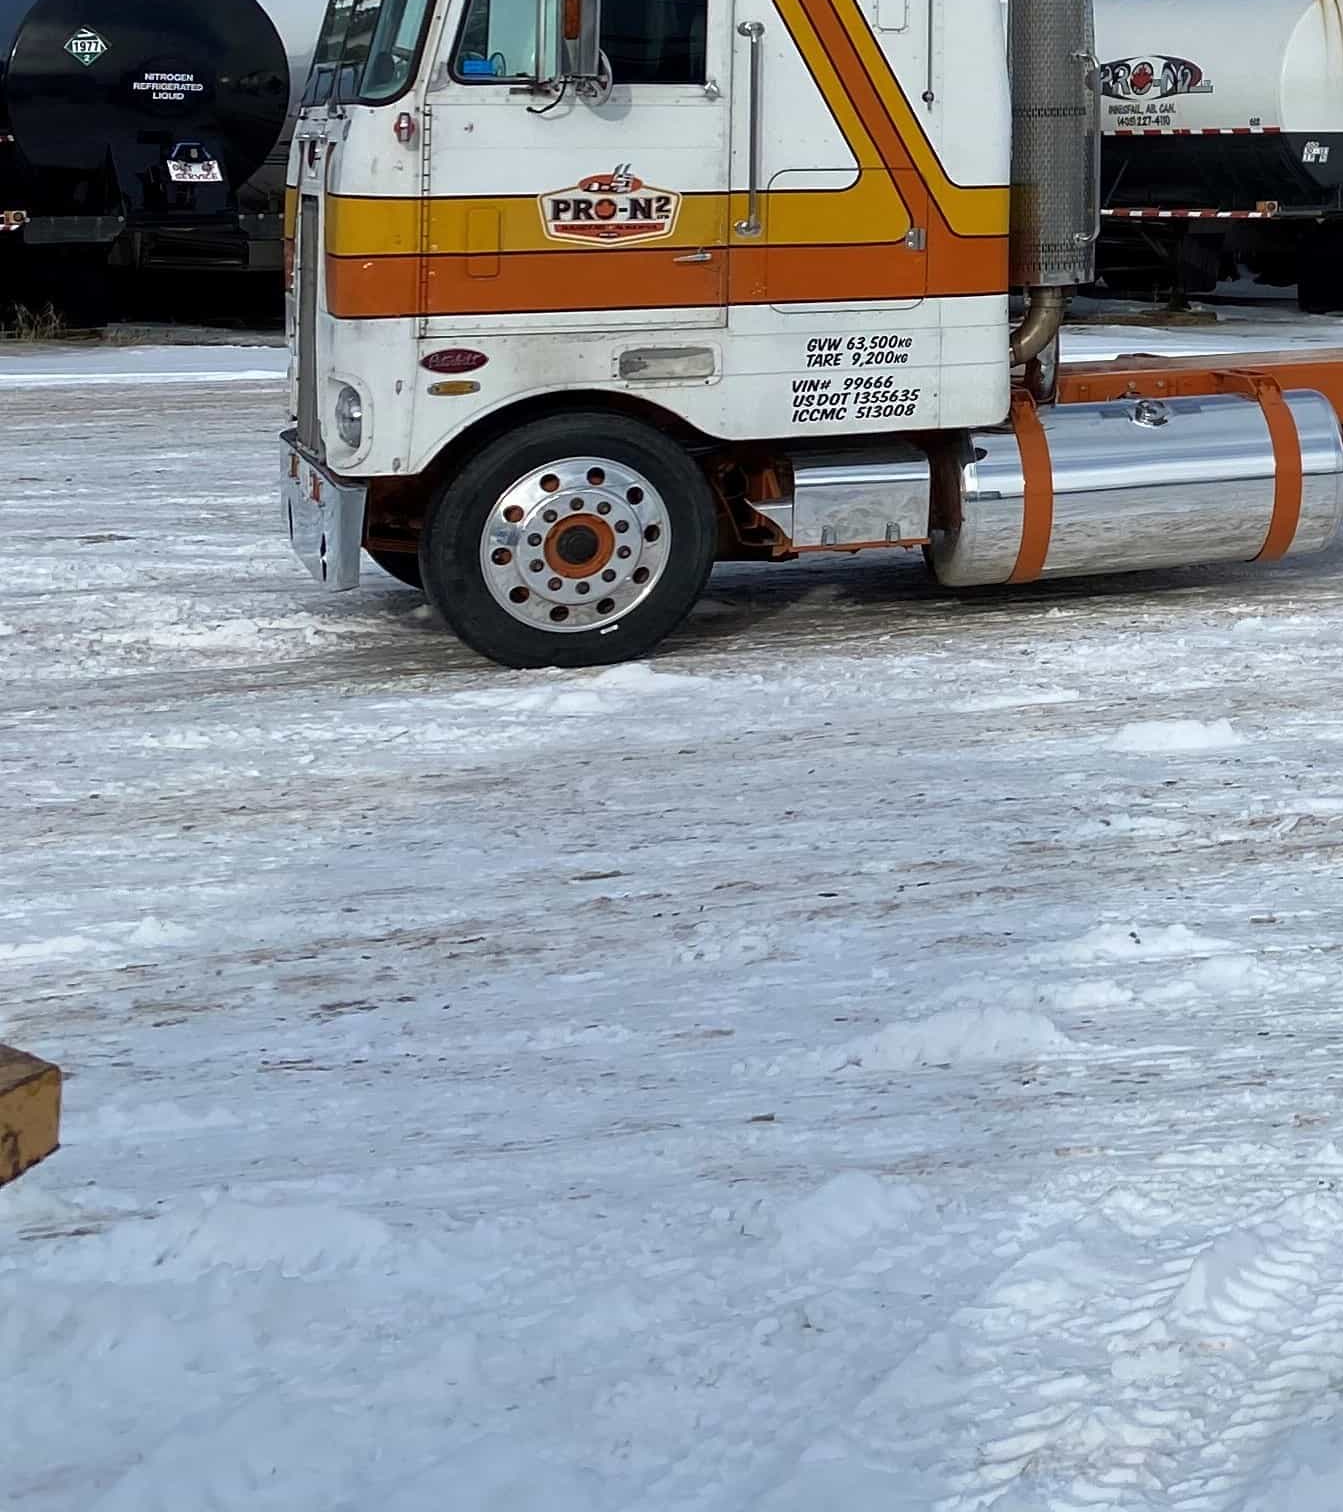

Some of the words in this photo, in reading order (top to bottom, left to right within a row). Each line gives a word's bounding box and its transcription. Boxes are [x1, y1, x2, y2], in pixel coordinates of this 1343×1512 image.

[73, 40, 99, 52] 1977
[144, 73, 194, 82] NITROGEN
[133, 82, 203, 92] REFRIGERATED
[152, 92, 184, 100] LIQUID
[1137, 116, 1171, 126] 227-4110
[807, 337, 842, 352] GVW
[806, 353, 843, 368] TARE
[792, 379, 831, 393] VIN#
[843, 375, 894, 390] 99666
[853, 389, 921, 405] 1355635
[792, 407, 847, 422] ICCMC
[854, 403, 916, 419] 513008
